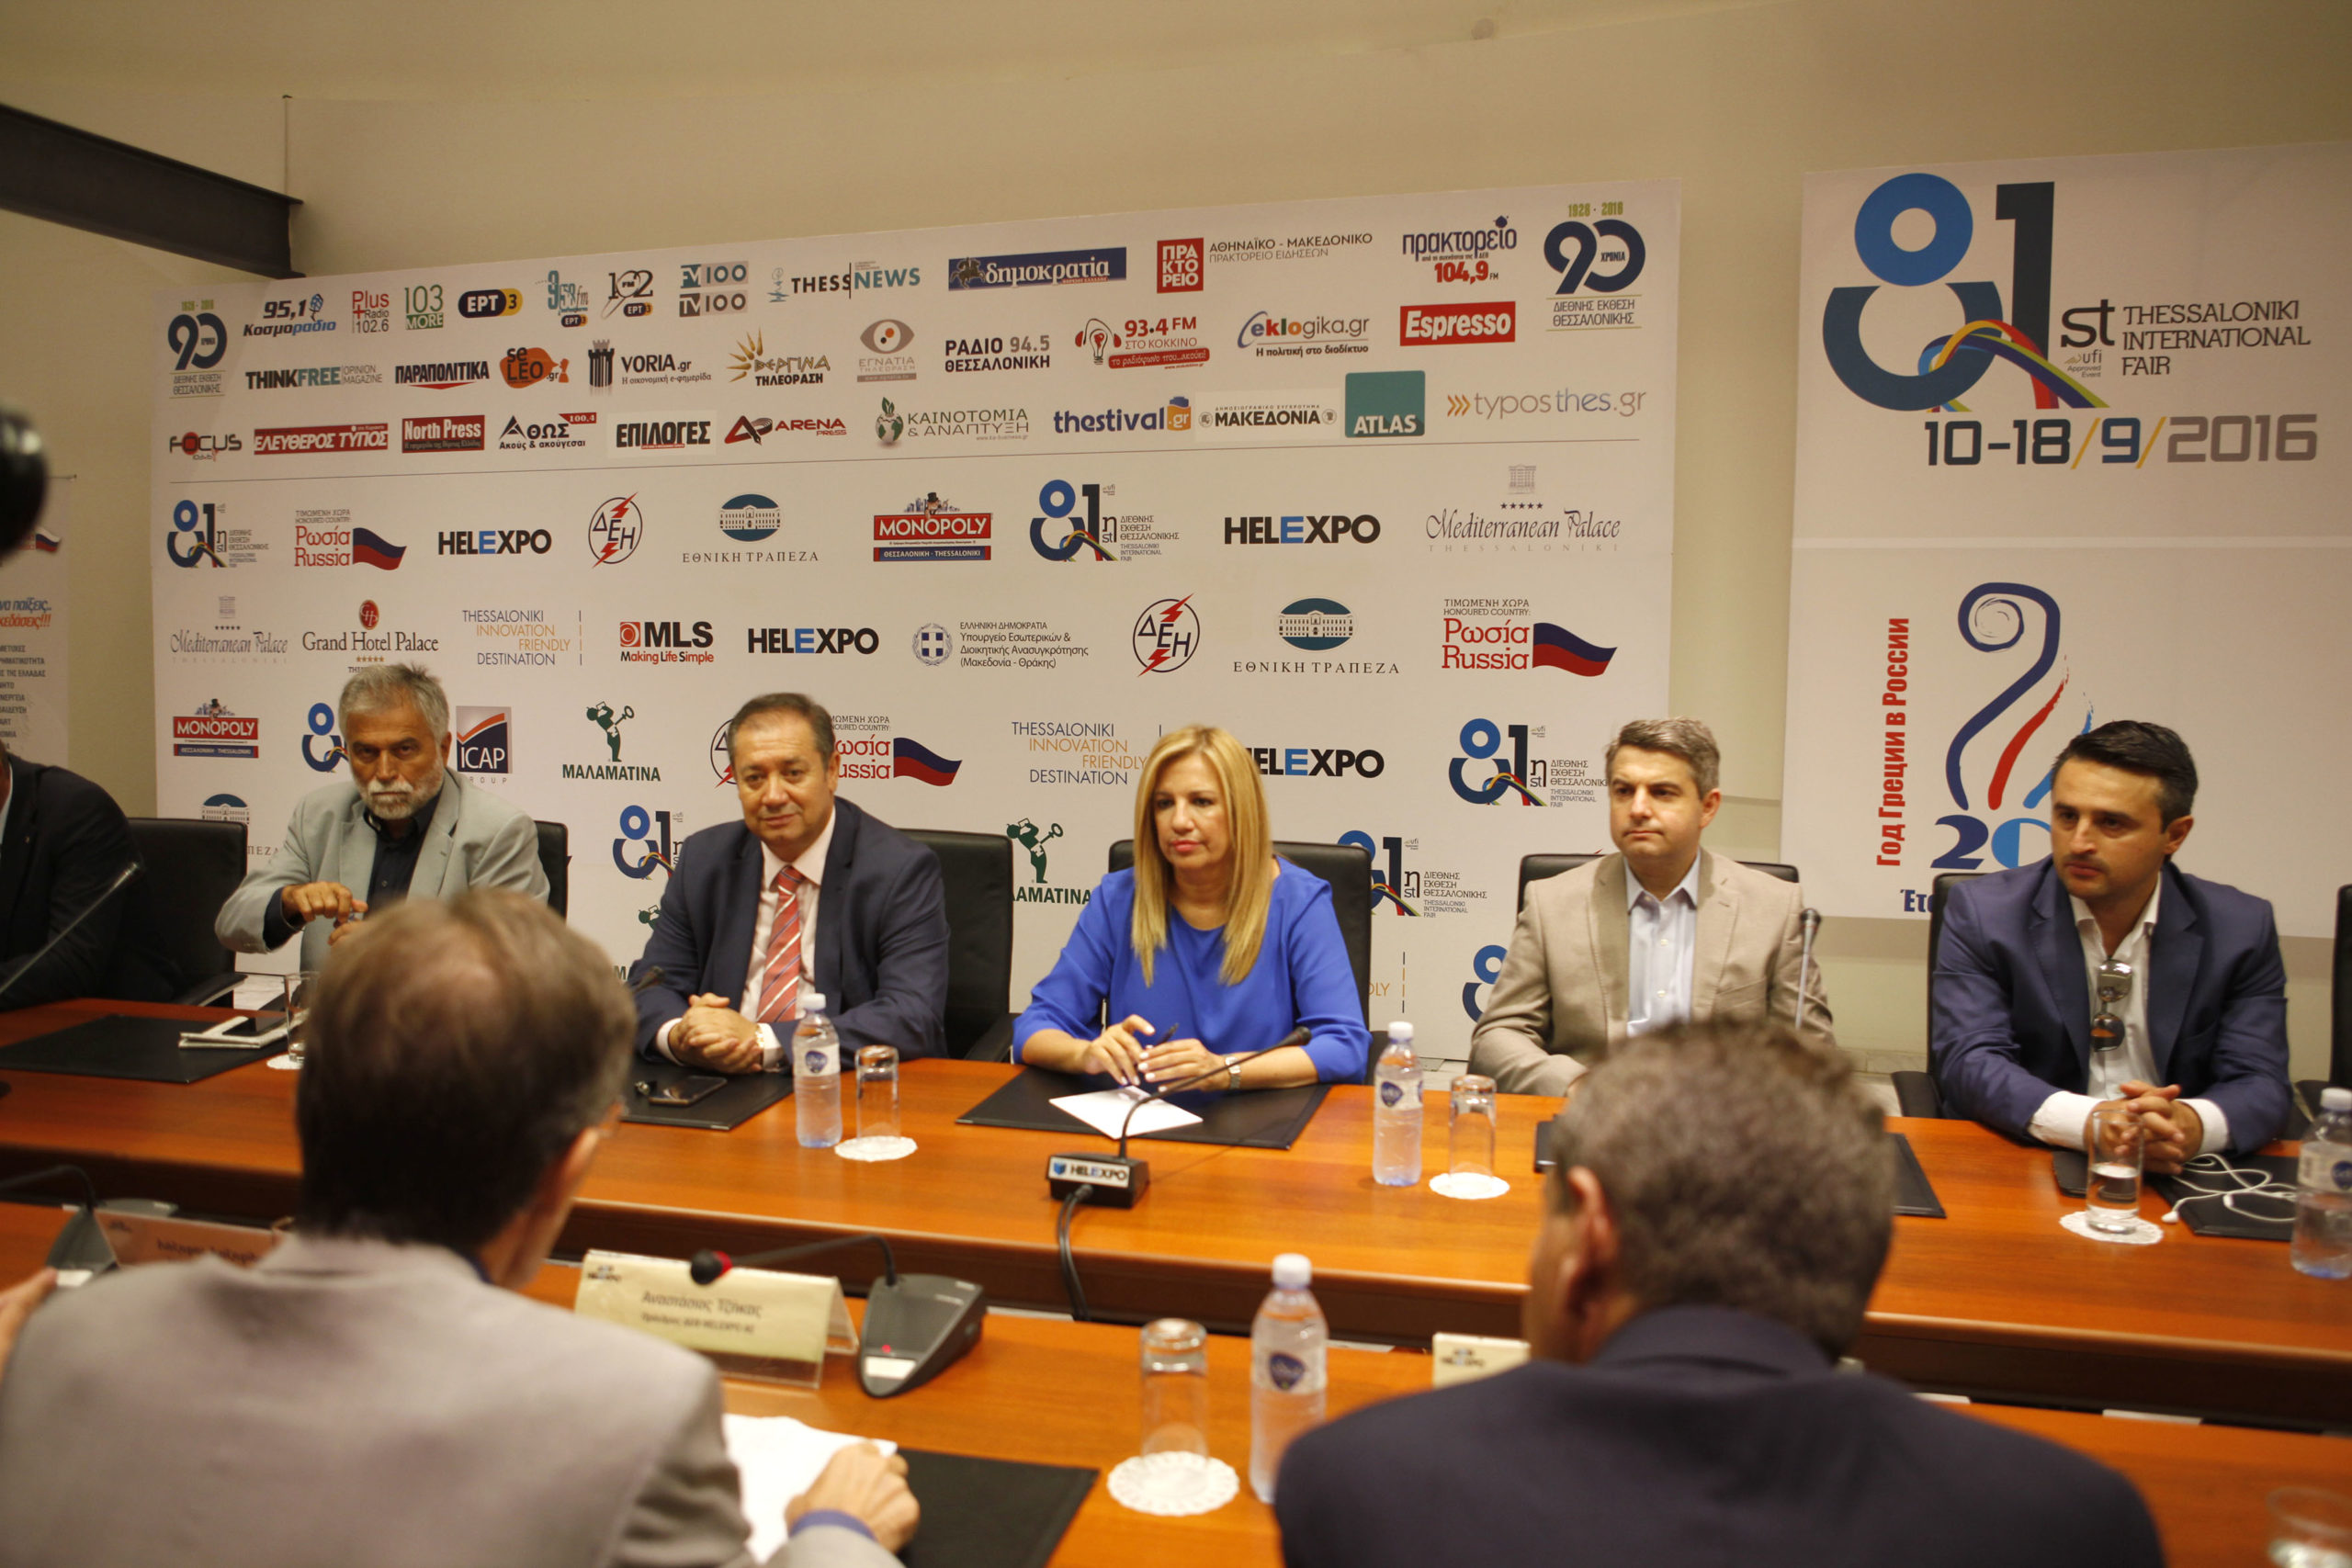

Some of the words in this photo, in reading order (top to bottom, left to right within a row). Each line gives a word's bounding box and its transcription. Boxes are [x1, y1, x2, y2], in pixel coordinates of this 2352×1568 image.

[1210, 237, 1275, 253] ΑΘΗΝΑΪΚΟ
[1287, 232, 1373, 249] ΜΑΚΕΔΟΝΙΚΟ
[1162, 244, 1198, 260] ΠΡΑ
[1210, 251, 1273, 265] ΠΡΑΚΤΟΡΕΙΟ
[1276, 247, 1329, 260] ΕΙΔΗΣΕΩΝ
[985, 255, 1110, 288] δημοκρατία
[1162, 260, 1198, 274] ΚΤΟ
[1434, 261, 1489, 285] 104,9
[792, 275, 851, 294] THESS
[854, 267, 921, 289] NEWS
[1162, 273, 1198, 288] ΡΕΙΟ
[353, 290, 390, 309] Plus
[404, 285, 444, 314] 103
[1554, 300, 1594, 313] ΔΙΕΘΝΗΣ
[1597, 299, 1635, 311] ΕΚΘΕΣΗ
[365, 309, 390, 318] Radio
[1553, 312, 1634, 327] ΘΕΣΣΑΛΟΝΙΚΗΣ
[2122, 299, 2300, 326] THESSALONIKI
[356, 319, 389, 333] 102.6
[405, 313, 444, 330] MORE
[1125, 318, 1169, 338] 93.4
[1172, 316, 1196, 331] FM
[1250, 316, 1370, 339] eklogika.gr
[1406, 310, 1511, 340] Espresso
[945, 338, 1003, 356] ΡΑΔΙΟ
[1010, 334, 1050, 354] 94.5
[1125, 341, 1146, 350] ΣΤΟ
[1148, 337, 1197, 348] ΚΟΚΚΙΝΟ
[2121, 326, 2311, 351] INTERNATIONAL
[1256, 348, 1263, 356] Η
[1266, 346, 1303, 357] πολιτική
[1306, 347, 1322, 355] στο
[2082, 349, 2102, 364] ufi
[621, 355, 692, 374] VORIA.gr
[859, 356, 914, 367] ΕΓΝΑΤΙΑ
[945, 355, 1050, 373] ΘΕΣΣΑΛΟΝΙΚΗ
[2121, 356, 2171, 377] FAIR
[343, 365, 376, 375] OPINION
[395, 361, 490, 384] ΠΑΡΑΠΟΛΙΤΙΚΑ
[343, 373, 382, 384] MAGAZINE
[755, 373, 823, 387] ΤΗΛΕΟΡΑΣΗ
[570, 414, 595, 423] 100.4
[908, 408, 1028, 425] ΚΑΙΝΟΤΟΜΙΑ
[1215, 411, 1320, 427] ΜΑΚΕΔΟΝΙΑ
[1353, 414, 1418, 434] ATLAS
[404, 421, 441, 440] North
[443, 419, 481, 438] Press
[775, 418, 845, 432] ARENA
[816, 427, 847, 436] PRESS
[908, 427, 919, 436] &
[924, 422, 1029, 436] ΑΝΑΠΤΥΞΗ
[254, 433, 336, 451] ΕΛΕΥΘΕΡΟΣ
[616, 421, 710, 448] ΕΠΙΛΟΓΕΣ
[499, 441, 526, 450] Ακούς
[529, 440, 537, 448] &
[539, 439, 586, 449] ακούγεσαι
[879, 517, 987, 536] MONOPOLY
[1120, 524, 1151, 532] ΕΚΘΕΣΗ
[1225, 514, 1381, 545] HELEXPO
[1426, 508, 1559, 539] Mediterranean
[1564, 507, 1621, 539] Palace
[295, 525, 351, 546] Ρωσία
[438, 529, 552, 555] HELEXPO
[1120, 532, 1180, 540] ΘΕΣΣΑΛΟΝΙΚΗΣ
[294, 547, 351, 567] Russia
[683, 552, 741, 563] ΕΘΝΙΚΗ
[747, 551, 819, 562] ΤΡΑΠΕΖΑ
[1444, 598, 1499, 608] ΤΙΜΩΜΕΝΗ
[1502, 598, 1530, 608] ΧΩΡΑ
[462, 610, 544, 623] THESSALONIKI
[1443, 608, 1488, 616] HONOURED
[476, 625, 555, 637] INNOVATION
[960, 622, 997, 630] ΕΛΛΗΝΙΚΗ
[999, 621, 1047, 630] ΔΗΜΟΚΡΑΤΙΑ
[1443, 617, 1530, 644] Ρωσία
[302, 632, 346, 651] Grand
[351, 631, 391, 651] Hotel
[395, 631, 439, 651] Palace
[645, 621, 714, 649] MLS
[748, 628, 879, 654] HELEXPO
[960, 632, 1006, 644] Υπουργείο
[1008, 632, 1062, 644] Εσωτερικών
[1063, 633, 1071, 642] &
[518, 639, 571, 651] FRIENDLY
[960, 645, 1009, 656] Διοικητικής
[1012, 645, 1089, 657] Ανασυγκρότησης
[477, 653, 556, 666] DESTINATION
[620, 650, 659, 663] Making
[660, 651, 678, 662] Life
[679, 651, 714, 665] Simple
[960, 657, 1012, 669] (Μακεδονία
[1018, 657, 1057, 669] Θράκης)
[1442, 645, 1530, 670] Russia
[1882, 618, 1909, 706] России
[1234, 661, 1306, 673] ΕΘΝΙΚΗ
[1312, 661, 1400, 674] ΤΡΑΠΕΖΑ
[177, 720, 254, 736] MONOPOLY
[867, 716, 890, 724] ΧΩΡΑ
[1012, 722, 1114, 737] THESSALONIKI
[836, 734, 890, 756] ωσία
[1029, 739, 1128, 753] INNOVATION
[461, 747, 505, 770] ICAP
[1082, 754, 1148, 770] FRIENDLY
[1246, 748, 1385, 778] ELEXPO
[1551, 760, 1588, 768] ΔΙΕΘΝΗΣ
[561, 763, 662, 783] ΜΑΛΑΜΑΤΙΝΑ
[838, 759, 891, 780] ussia
[1030, 769, 1128, 785] DESTINATION
[1551, 769, 1585, 777] ΕΚΘΕΣΗ
[1878, 731, 1908, 818] Греции
[1876, 824, 1905, 866] Год
[1424, 872, 1460, 880] ΔΙΕΘΝΗΣ
[1424, 880, 1456, 888] ΕΚΘΕΣΗ
[1423, 889, 1487, 899] ΘΕΣΣΑΛΟΝΙΚΗΣ
[1070, 1165, 1127, 1181] HELEXPO
